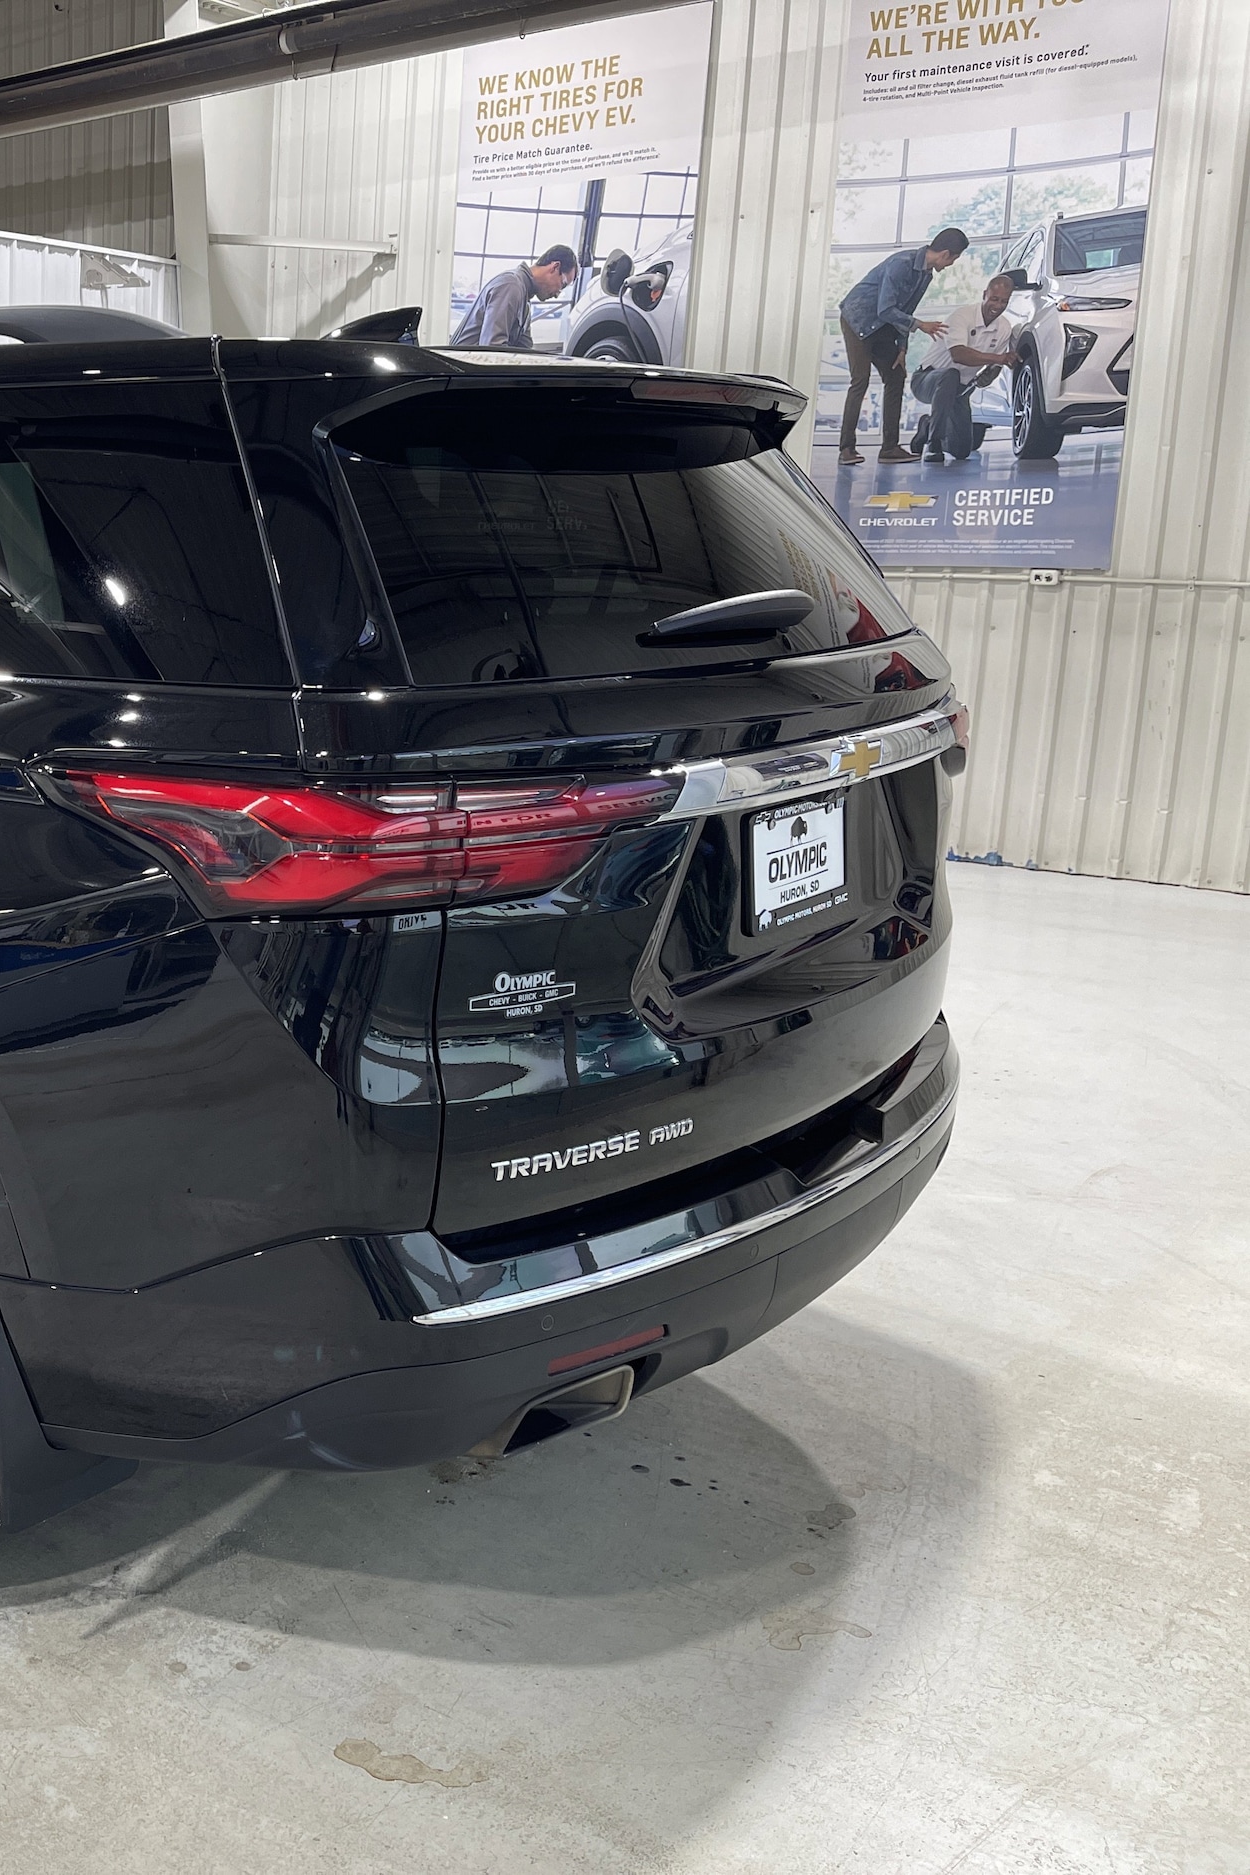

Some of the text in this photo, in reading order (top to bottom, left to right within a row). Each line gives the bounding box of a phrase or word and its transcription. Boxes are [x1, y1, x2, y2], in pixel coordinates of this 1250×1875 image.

[870, 0, 1024, 31] WE'RE WITH
[866, 17, 1041, 59] ALL THE WAY.
[478, 55, 621, 96] WE KNOW THE
[864, 72, 889, 82] Your
[892, 69, 916, 80] first
[919, 61, 992, 78] maintenance
[995, 56, 1020, 68] visit
[1024, 54, 1033, 64] is
[476, 77, 644, 121] RIGHT TIRES FOR
[916, 88, 949, 97] Multi-Point
[950, 86, 971, 94] Vehicle
[475, 104, 636, 145] YOUR CHEVY EV.
[473, 143, 593, 164] Tire Price Match Guarantee.
[954, 487, 1054, 507] CERTIFIED
[859, 517, 938, 527] CHEVROLET
[952, 508, 1034, 526] SERVICE
[768, 841, 828, 884] OLYMPIC
[780, 880, 820, 904] HURON, SD
[834, 892, 848, 904] GMC
[494, 971, 556, 992] OLYMPIC
[488, 996, 510, 1006] CHEVY
[518, 992, 538, 1002] BUICK
[544, 988, 558, 998] GMC
[506, 1004, 543, 1017] HURON, SD
[491, 1118, 694, 1182] TRAVERSE AWD
